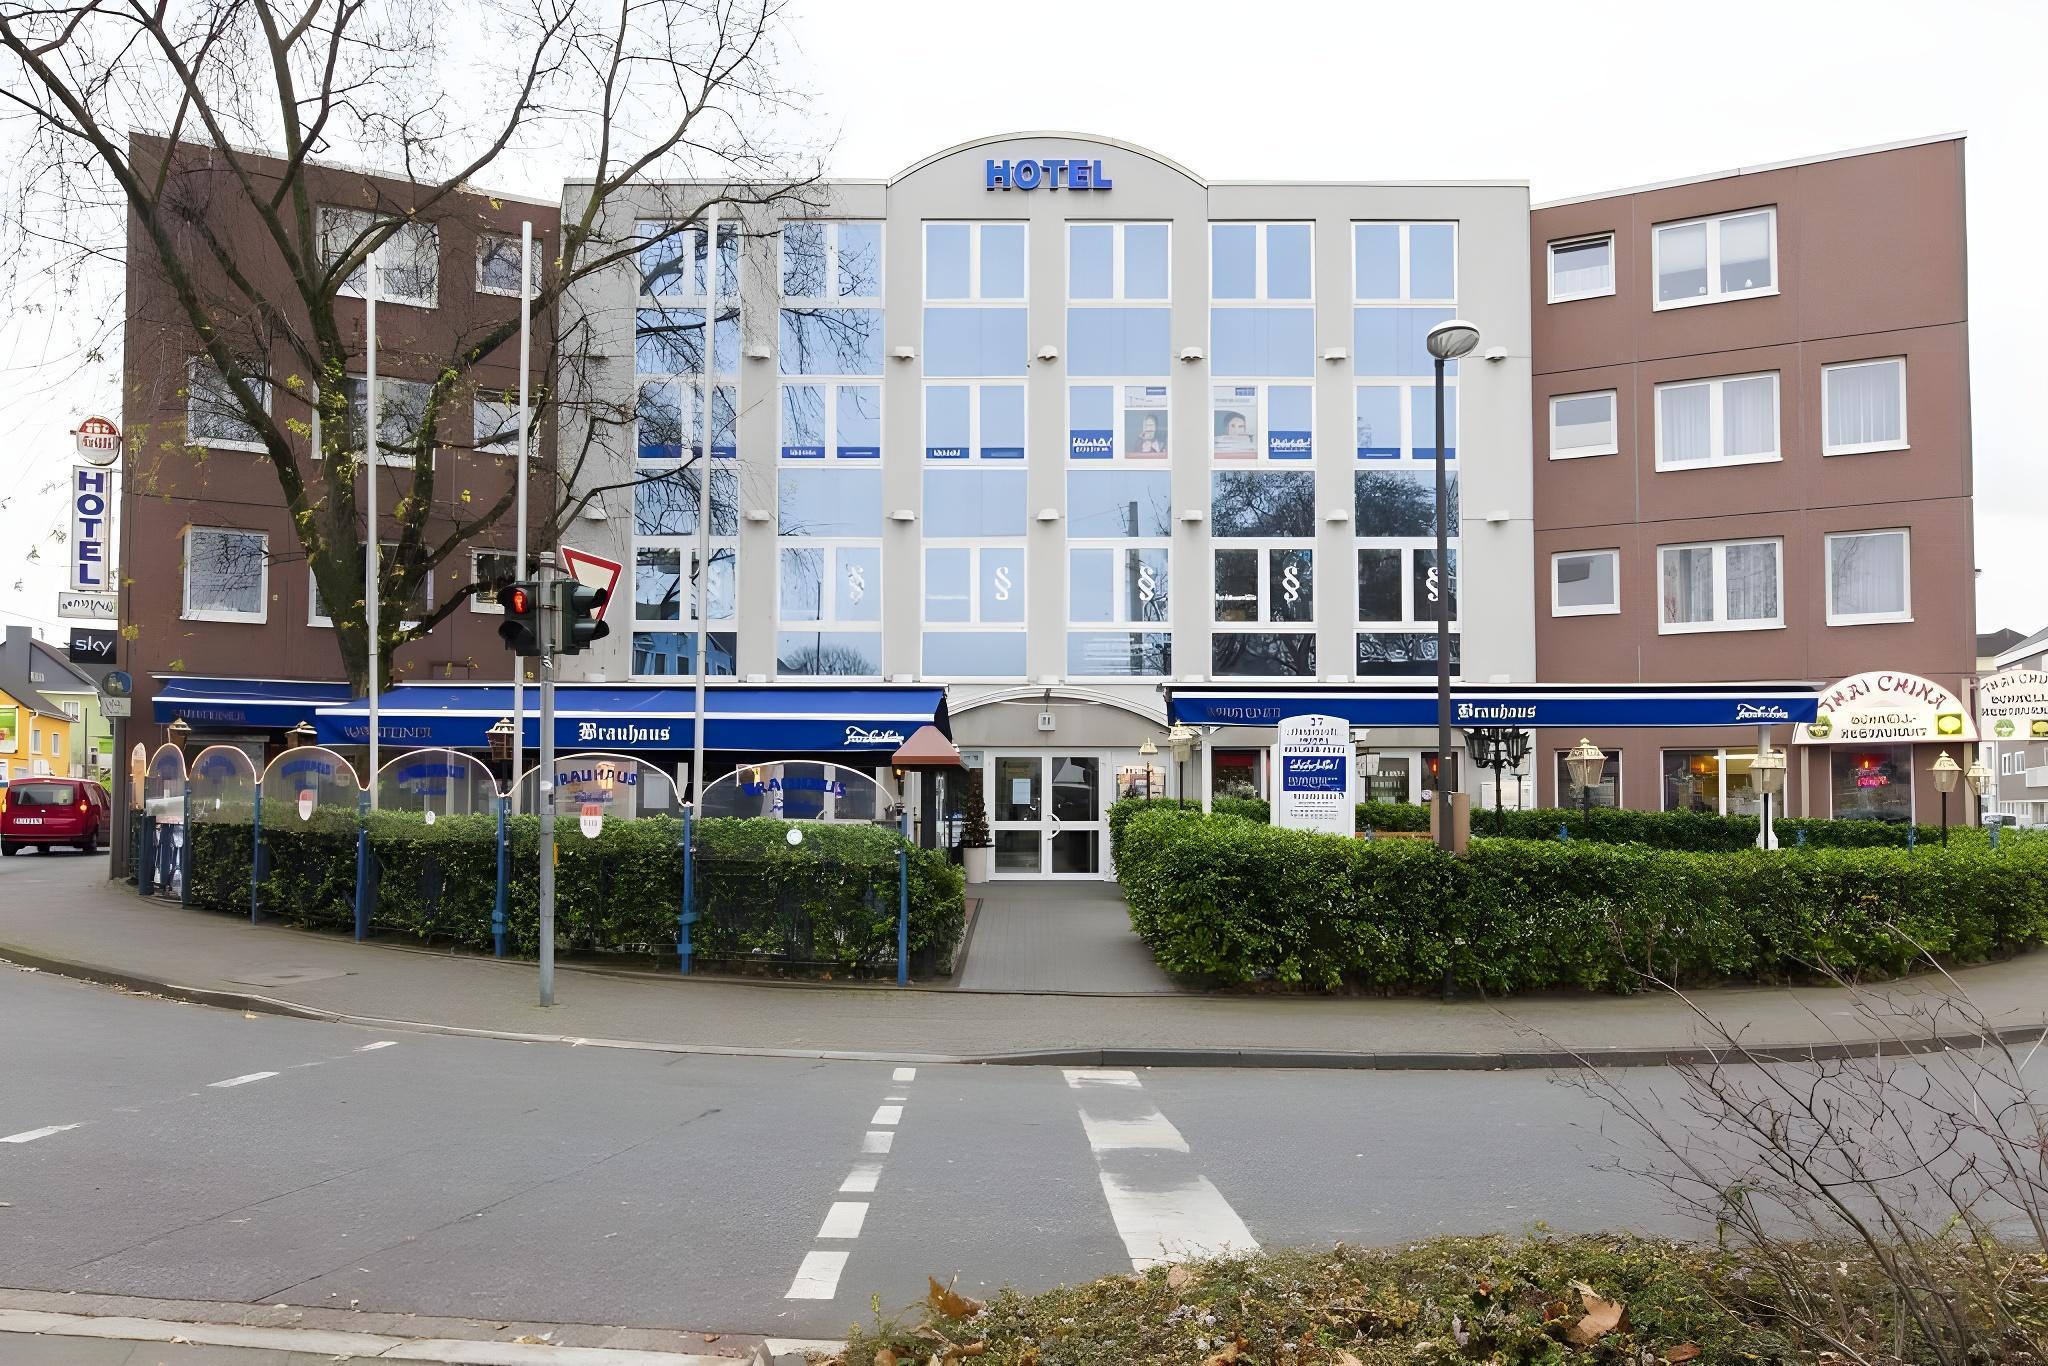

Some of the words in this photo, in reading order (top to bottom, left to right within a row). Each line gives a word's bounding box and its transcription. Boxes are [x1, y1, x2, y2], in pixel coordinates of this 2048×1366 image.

[986, 159, 1113, 190] HOTEL
[77, 471, 105, 585] HOTEL
[75, 635, 113, 656] sky
[1457, 703, 1537, 720] Brauhaus
[578, 722, 671, 744] Brauhaus
